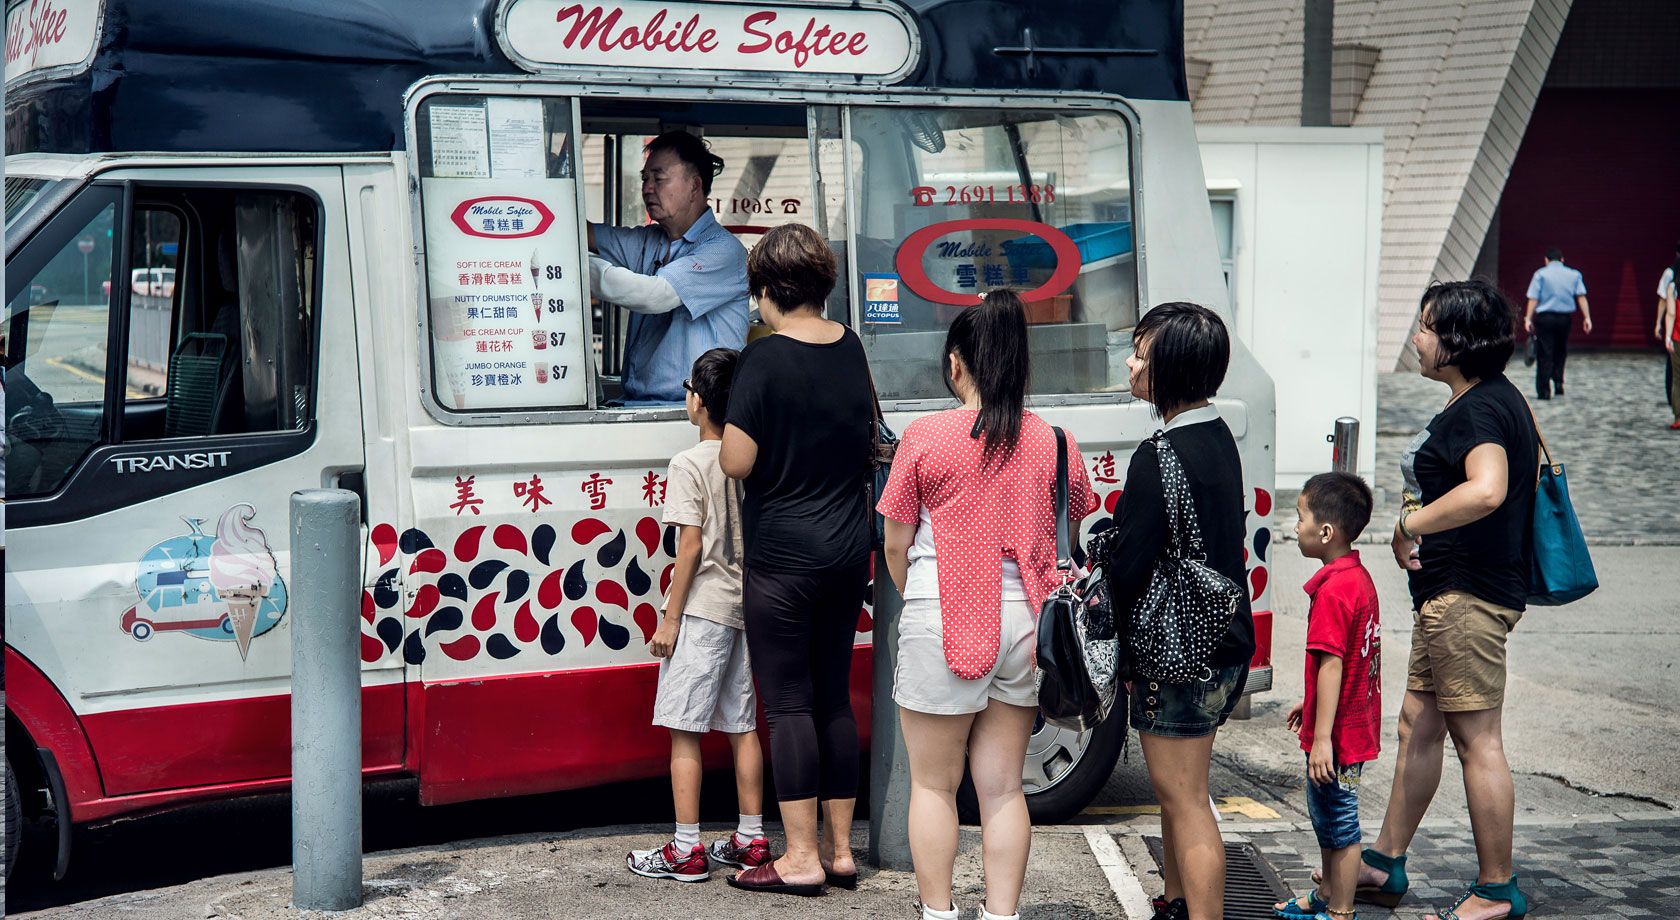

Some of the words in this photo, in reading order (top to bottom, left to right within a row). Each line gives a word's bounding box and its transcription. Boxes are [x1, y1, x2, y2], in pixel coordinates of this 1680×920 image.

[557, 4, 719, 52] Mobile
[737, 11, 869, 68] Softee
[945, 185, 995, 205] 2691
[1006, 184, 1056, 204] 1388
[471, 205, 503, 216] Mobile
[506, 206, 534, 218] Softee
[482, 218, 525, 232] 雪糕車
[937, 241, 993, 258] Mobile
[456, 261, 477, 269] SOFT
[458, 273, 522, 286] 香滑軟雪糕
[546, 265, 562, 280] $8
[956, 263, 1032, 288] 雪糕車
[454, 295, 480, 303] NUTTY
[482, 294, 528, 302] DRUMSTICK
[548, 298, 564, 313] $8
[467, 306, 518, 319] 果仁甜筒
[478, 328, 506, 336] CREAM
[475, 340, 513, 353] 蓮花杯
[550, 332, 566, 347] $7
[465, 362, 492, 370] JUMBO
[493, 361, 527, 369] ORANGE
[552, 365, 568, 380] $7
[471, 373, 522, 387] 珍寶橙冰
[111, 451, 232, 473] TRANSIT
